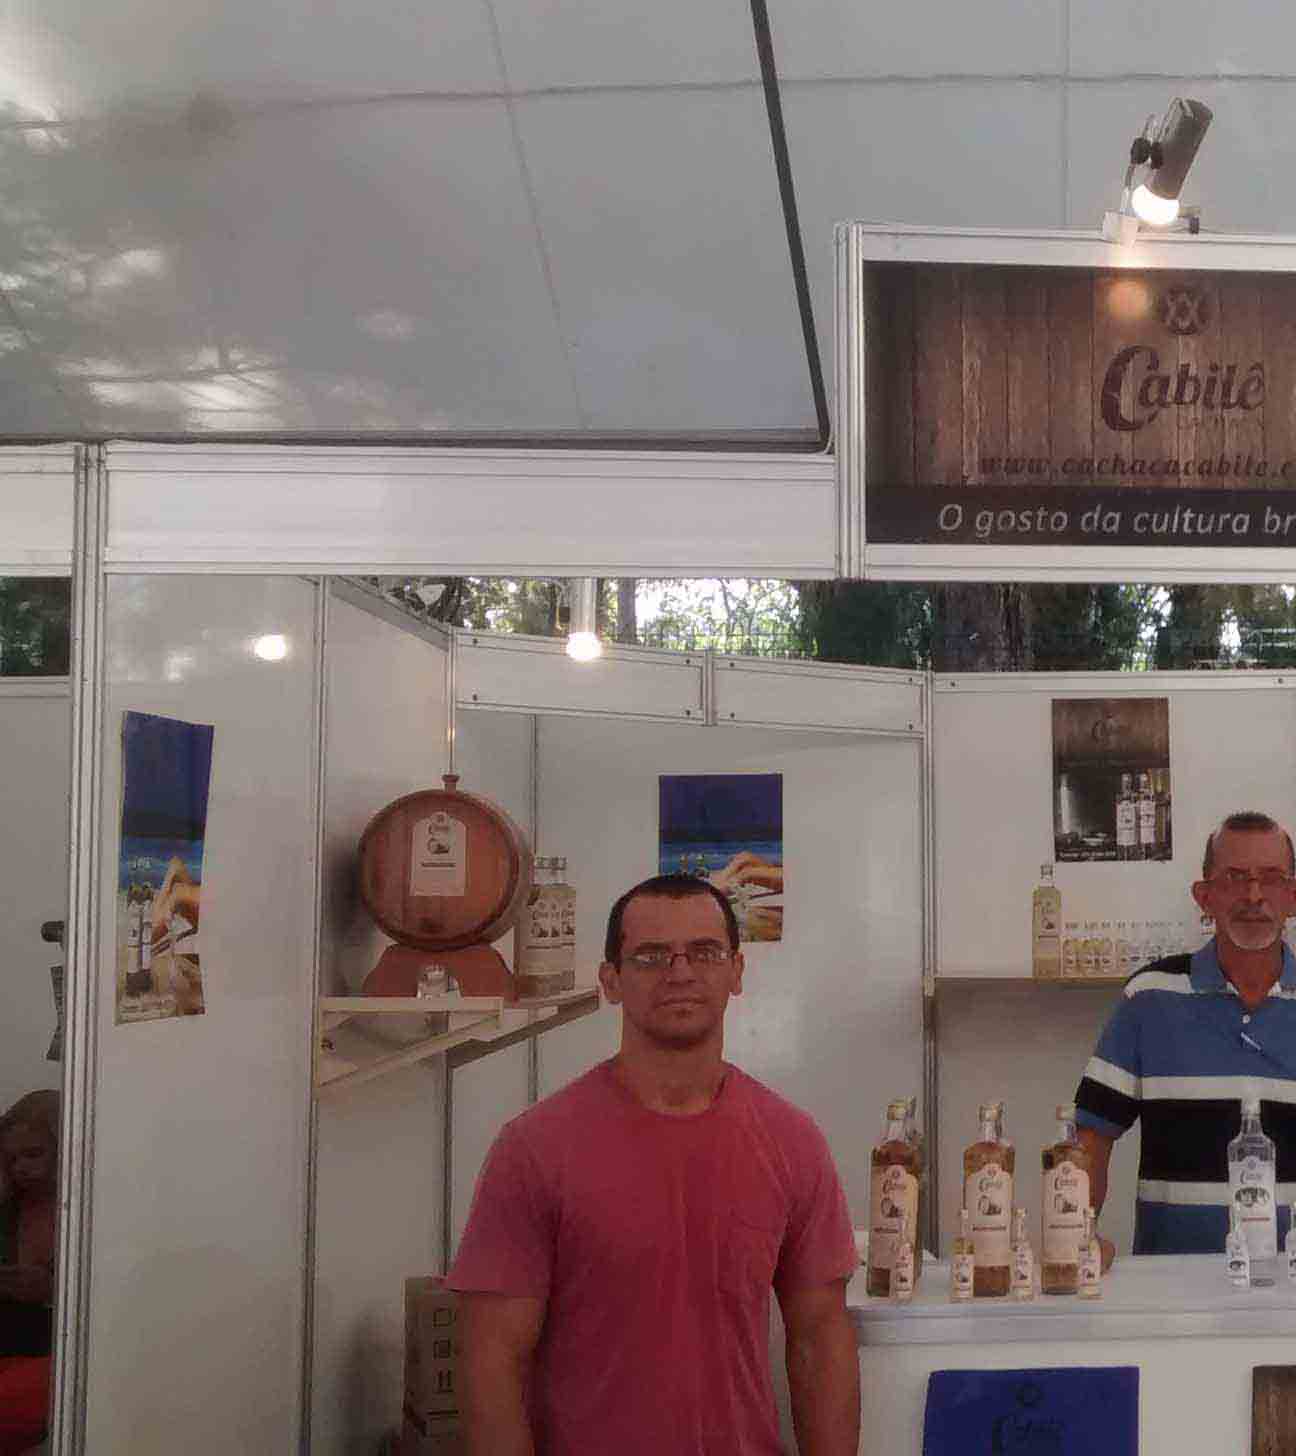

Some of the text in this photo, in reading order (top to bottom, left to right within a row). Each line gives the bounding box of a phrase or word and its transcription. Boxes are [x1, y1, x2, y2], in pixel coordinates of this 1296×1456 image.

[938, 505, 964, 532] O
[975, 504, 1069, 539] gosto
[1080, 504, 1121, 534] da
[1133, 504, 1251, 534] cultura
